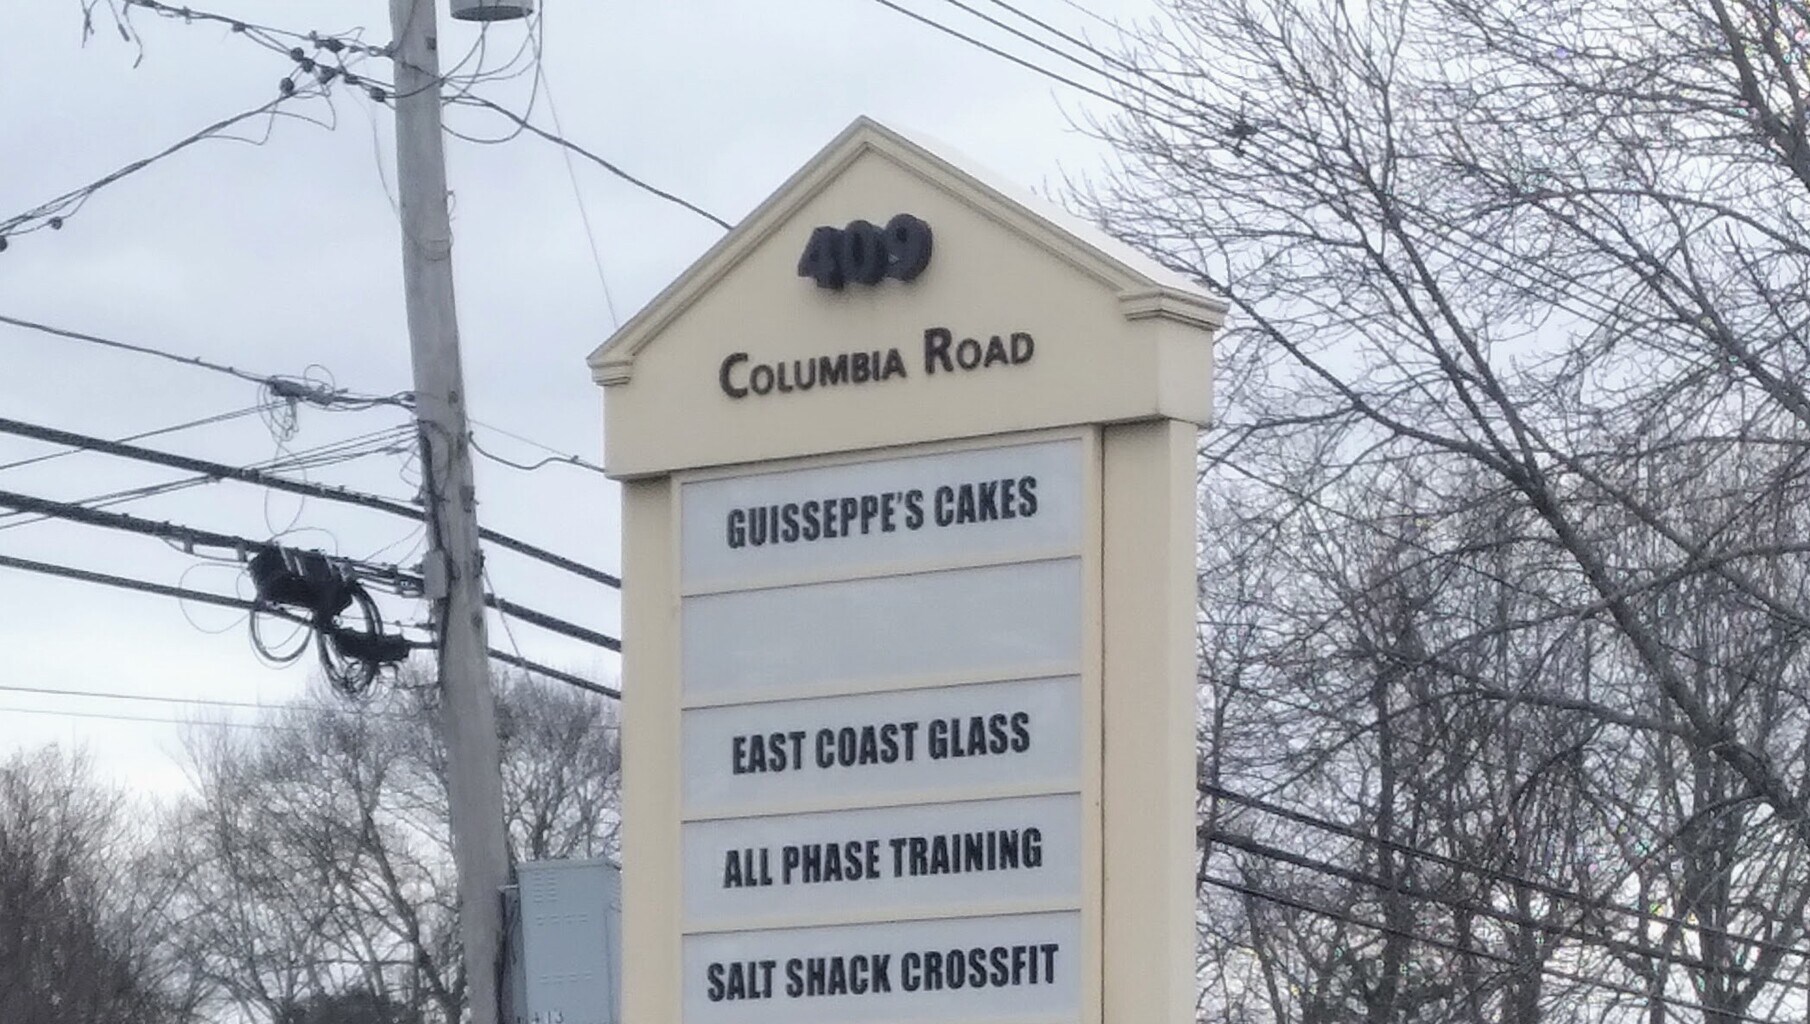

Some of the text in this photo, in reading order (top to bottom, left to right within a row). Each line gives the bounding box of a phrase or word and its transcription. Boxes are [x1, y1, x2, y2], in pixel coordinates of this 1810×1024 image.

[798, 213, 933, 291] 409
[719, 327, 1036, 399] COLUMBIA ROAD
[726, 476, 1039, 549] GUISSEPPE'S CAKES
[731, 711, 1031, 775] EAST COAST GLASS
[723, 827, 1042, 889] ALL PHASE TRAINING
[707, 943, 1060, 1002] SALT SHACK CROSSFIT
